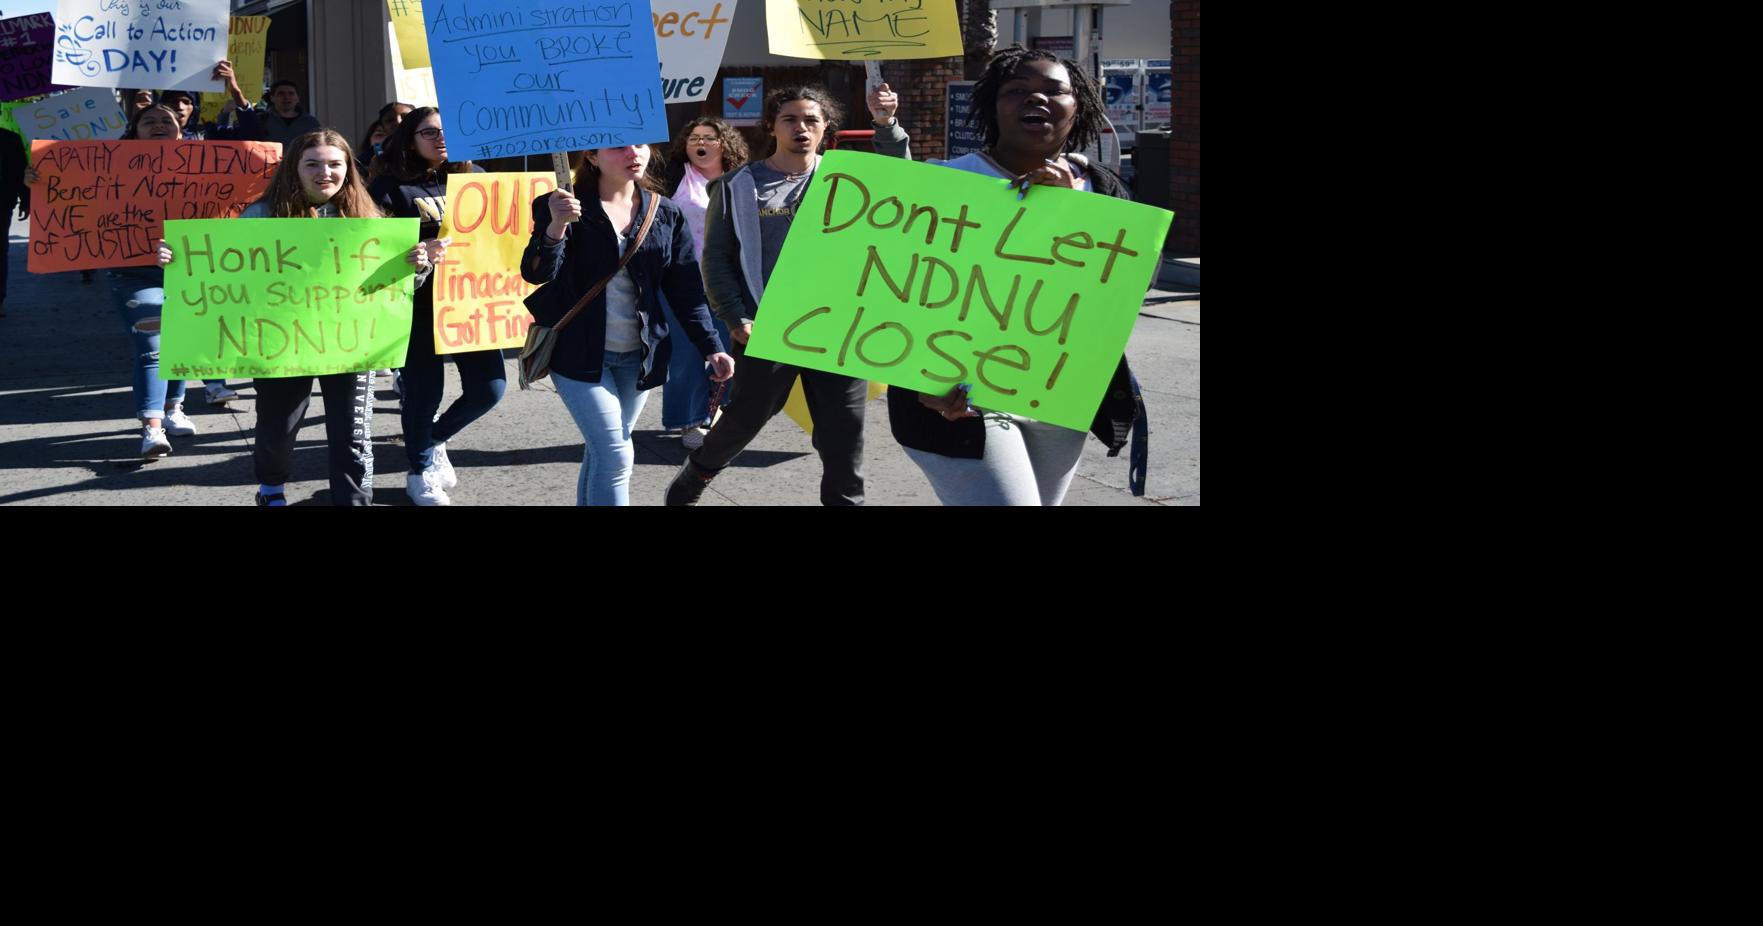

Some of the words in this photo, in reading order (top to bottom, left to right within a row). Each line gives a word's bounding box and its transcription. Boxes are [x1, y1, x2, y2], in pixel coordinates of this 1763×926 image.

[0, 15, 54, 35] LMARK
[74, 15, 116, 41] Call
[126, 22, 144, 40] to
[150, 16, 216, 41] Action
[799, 8, 930, 38] NAME
[102, 48, 177, 73] DAY!
[464, 44, 516, 73] you
[513, 69, 570, 91] our
[660, 66, 705, 99] ure
[33, 99, 97, 130] Save
[458, 87, 656, 136] Community!
[34, 143, 122, 174] APATHY
[128, 145, 163, 173] and
[167, 144, 280, 179] SILENCE
[47, 175, 126, 203] Benefit
[132, 178, 235, 200] Nothing
[34, 205, 89, 232] WE
[97, 213, 120, 227] are
[123, 202, 155, 223] the
[822, 173, 981, 252] Dont
[995, 207, 1138, 283] Let
[34, 233, 58, 256] of
[63, 224, 161, 262] JUSTICE
[182, 234, 303, 276] Honk
[328, 237, 382, 274] if
[181, 281, 251, 316] you
[266, 276, 404, 313] support
[857, 245, 1080, 346] NDNU
[217, 315, 377, 360] NDNU!
[437, 306, 484, 347] Got
